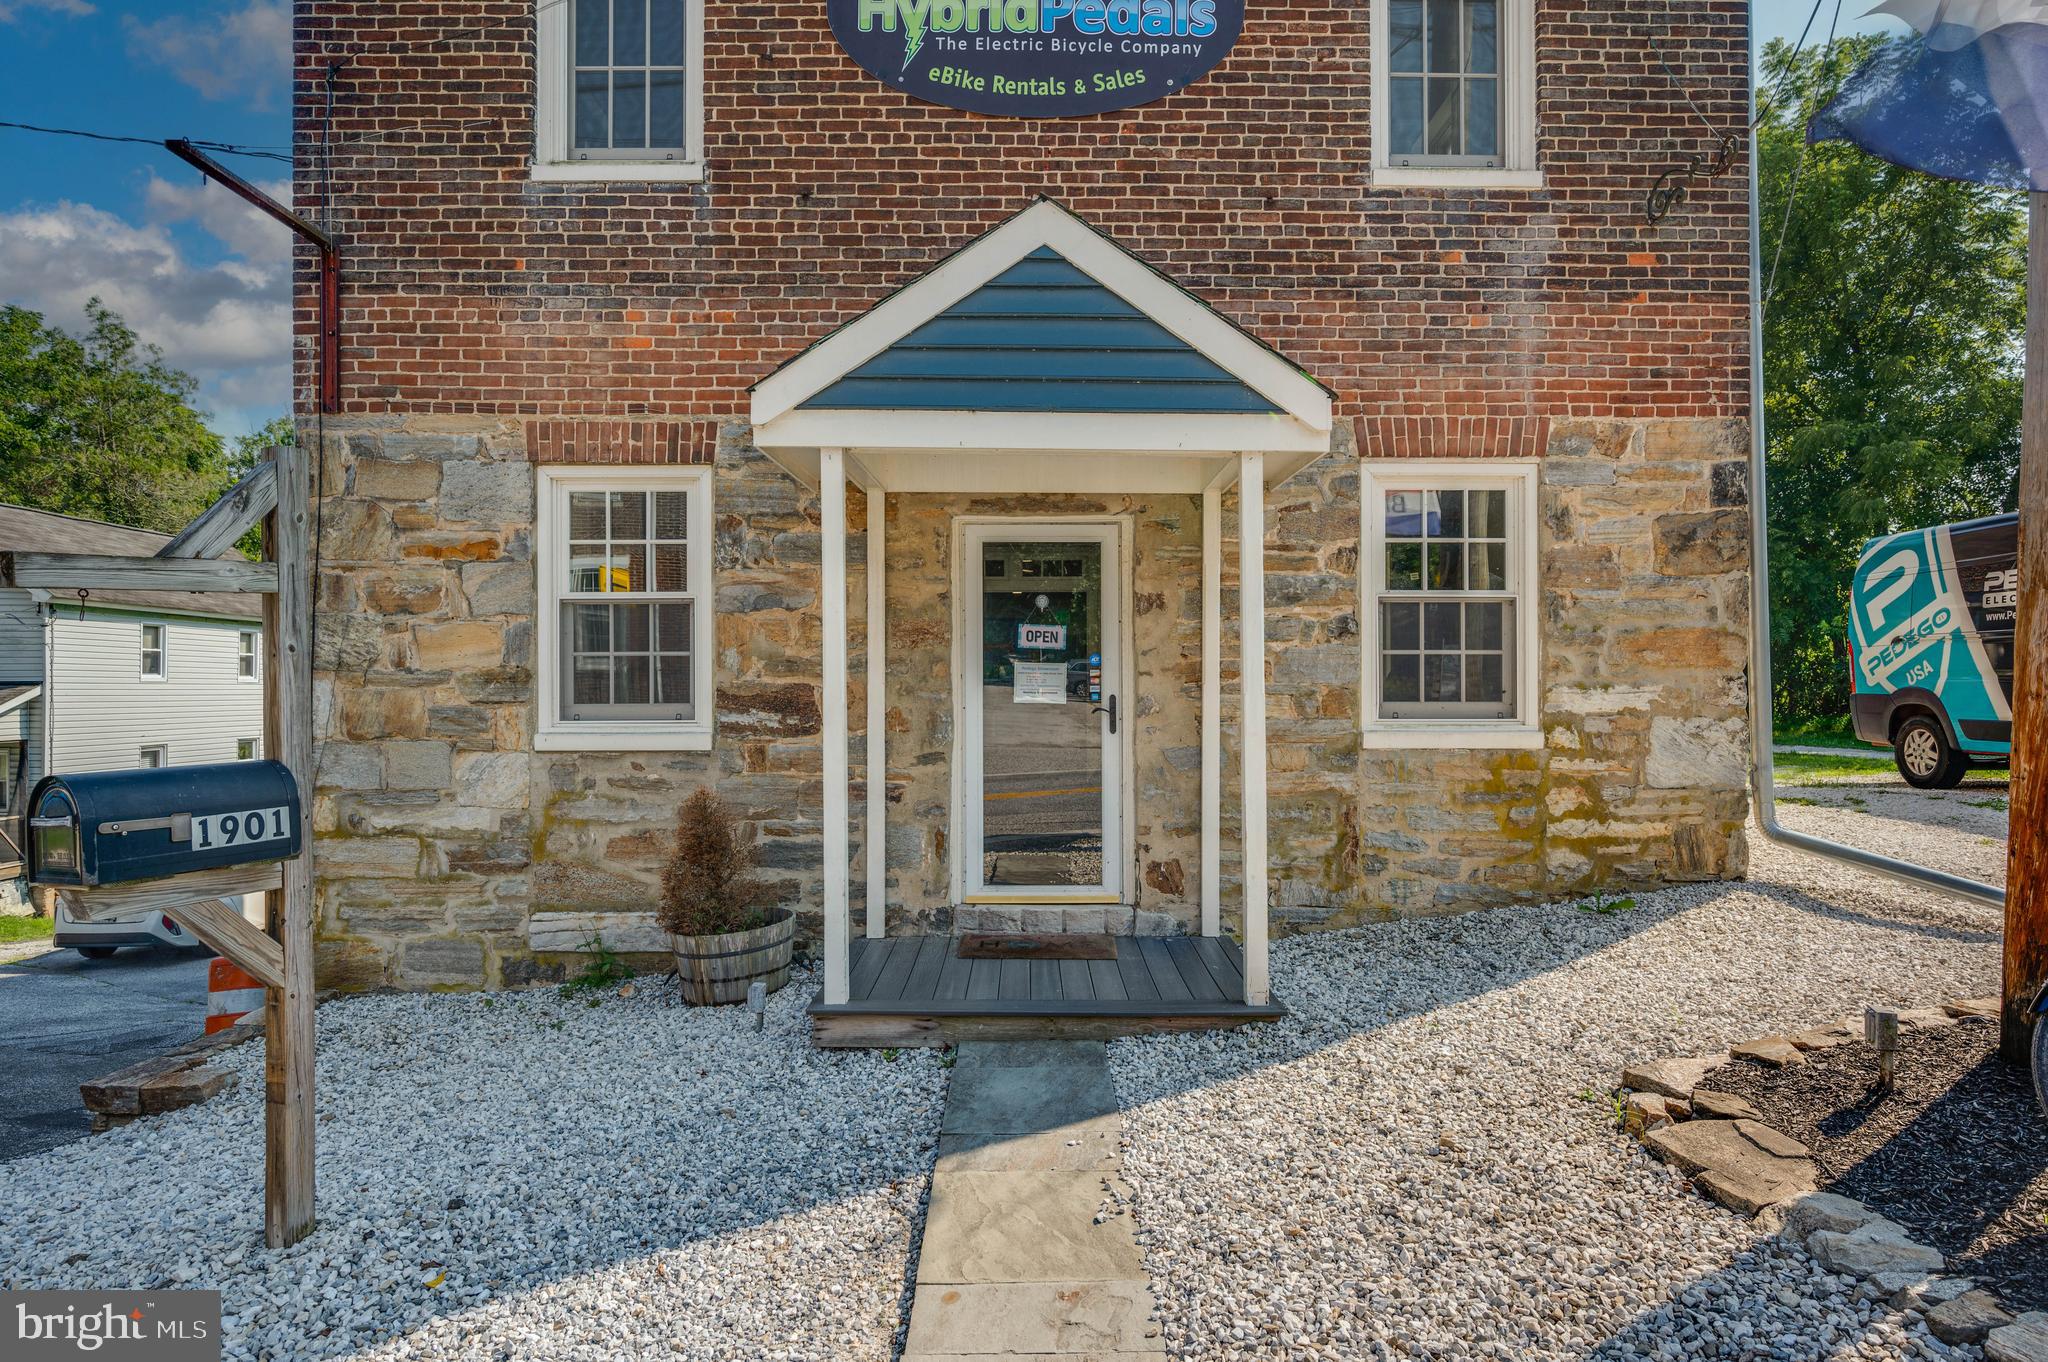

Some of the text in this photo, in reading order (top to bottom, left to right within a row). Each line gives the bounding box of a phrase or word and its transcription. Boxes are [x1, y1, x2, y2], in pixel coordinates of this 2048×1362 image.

[935, 36, 1202, 57] The Electric Bicycle Company
[928, 65, 1146, 96] eBike Rentals & Sales
[1026, 630, 1059, 643] OPEN
[1867, 607, 1951, 677] PEDEGO
[1905, 659, 1934, 686] USA
[198, 808, 285, 849] 1901
